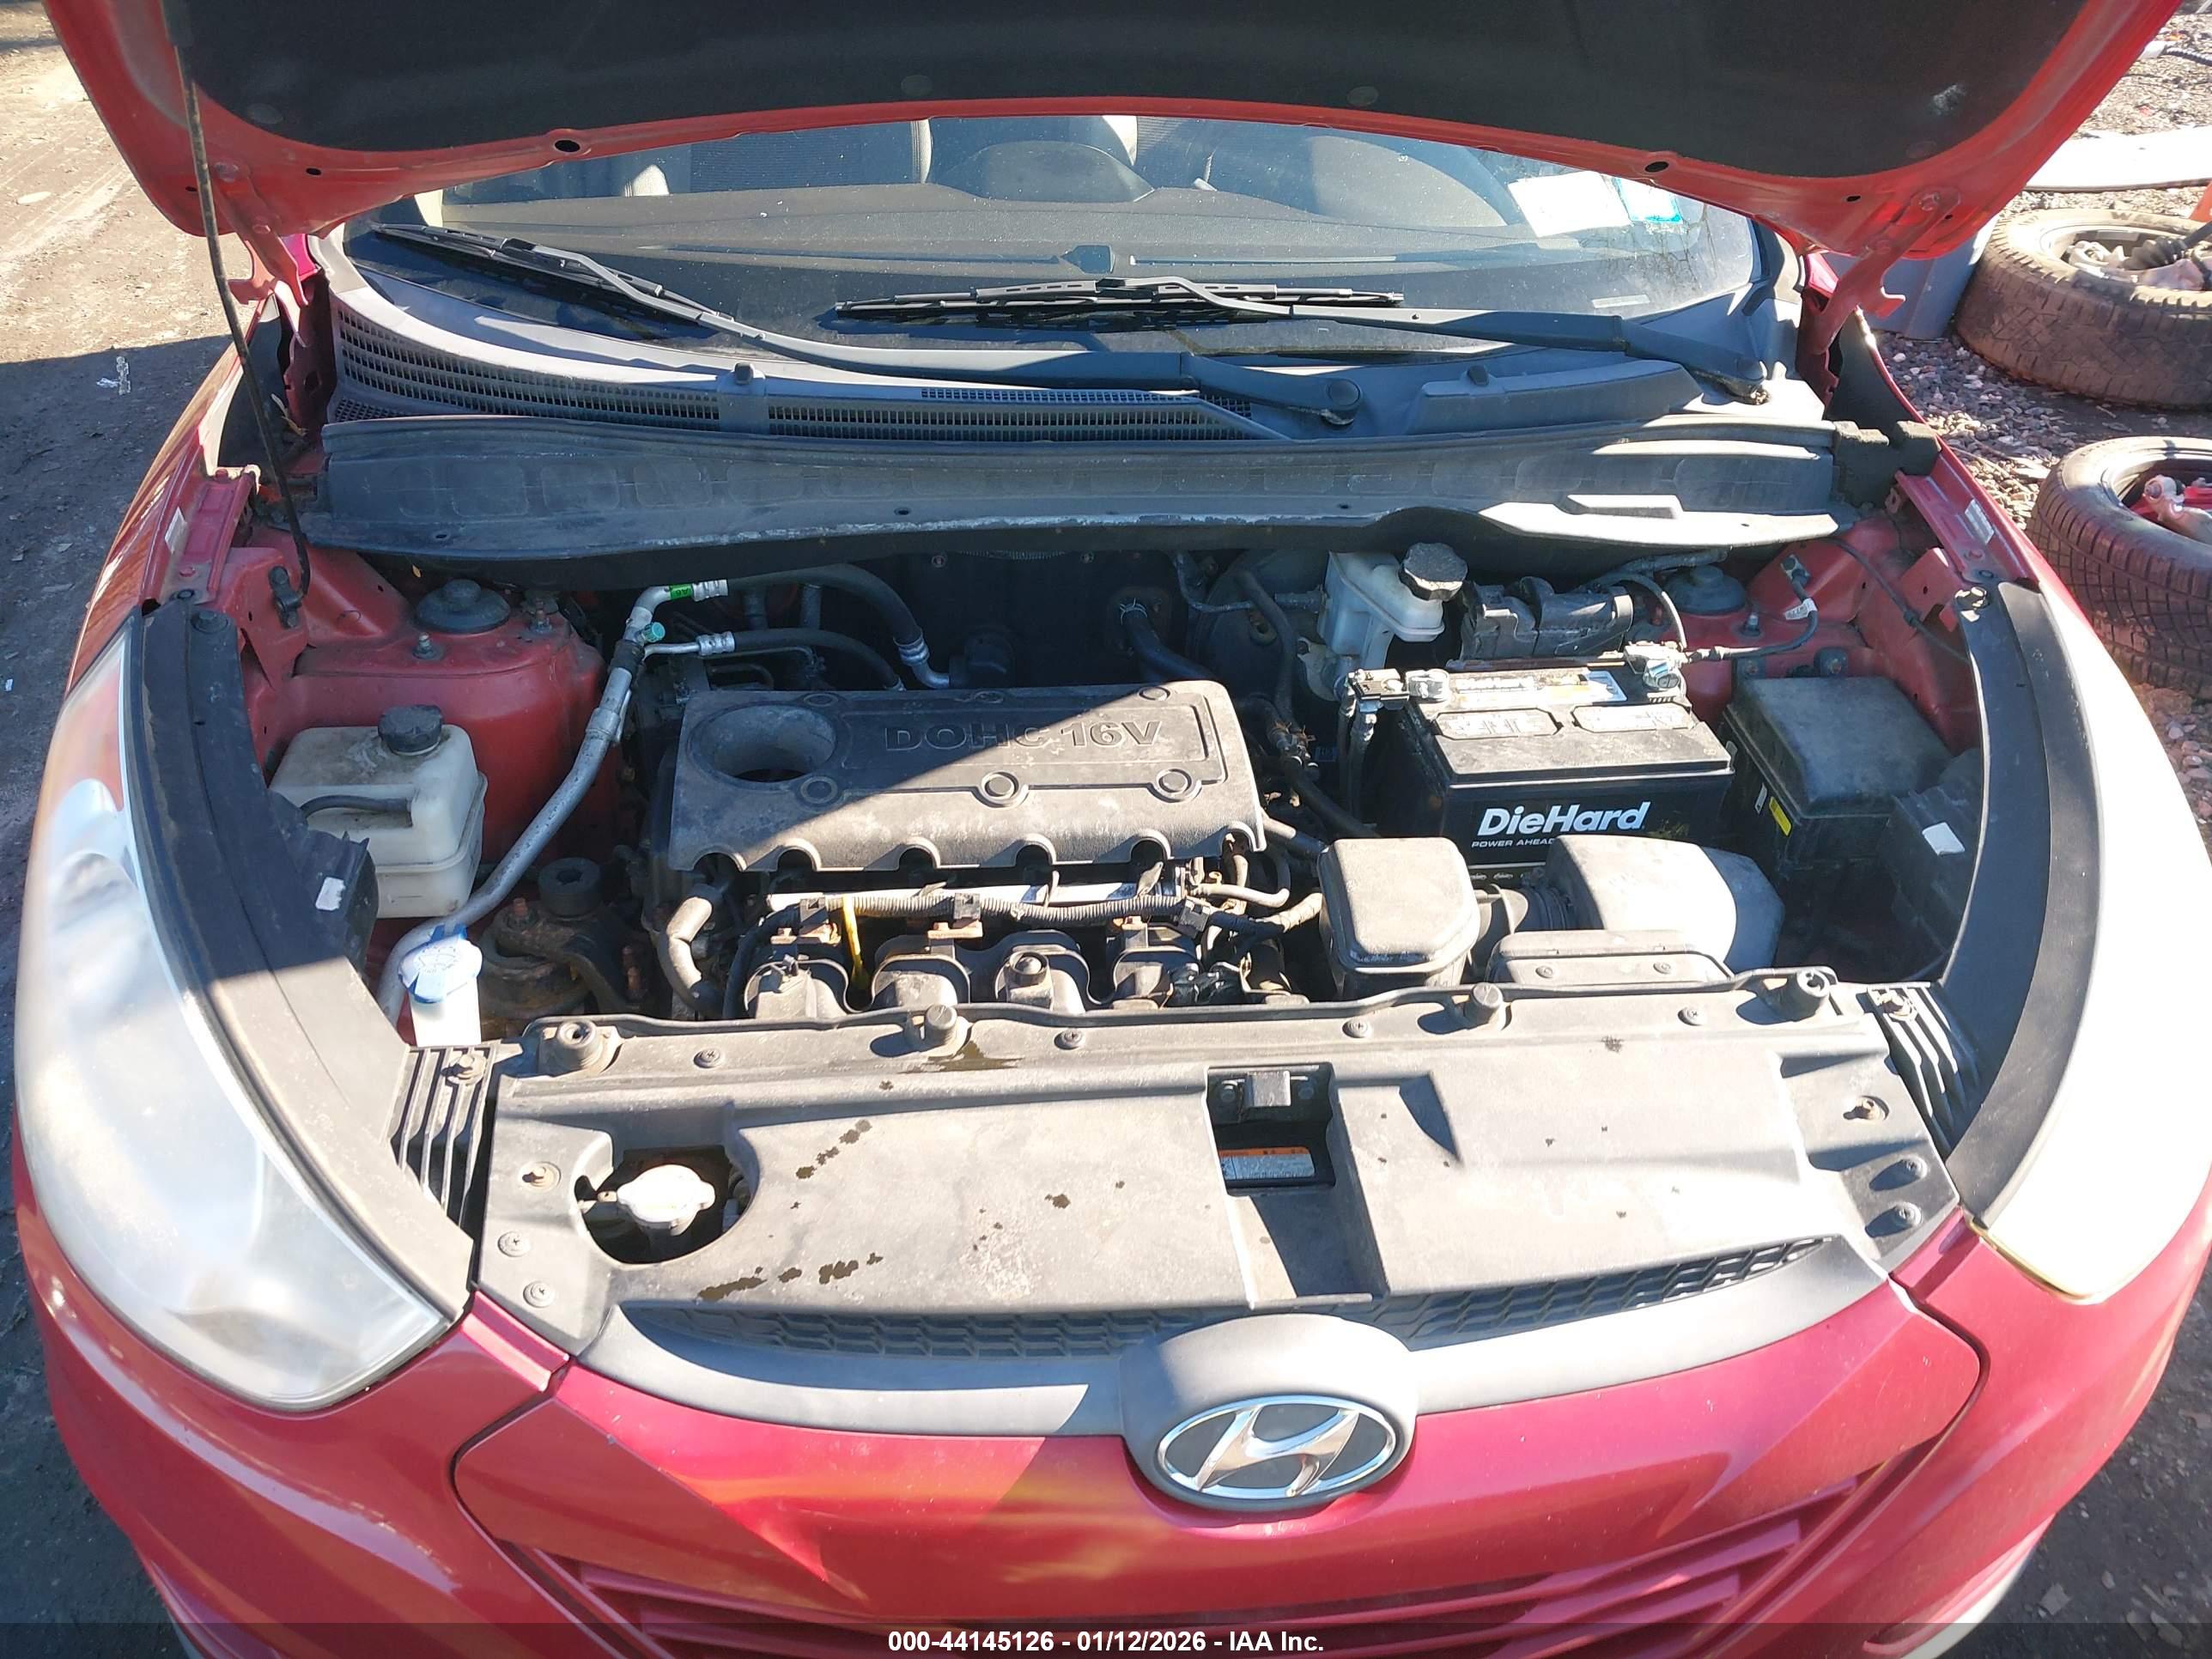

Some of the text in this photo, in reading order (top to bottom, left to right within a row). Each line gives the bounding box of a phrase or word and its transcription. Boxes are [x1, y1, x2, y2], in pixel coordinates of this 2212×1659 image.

[884, 720, 1162, 750] DOHC 16V
[1477, 801, 1651, 836] DieHard
[1471, 840, 1514, 848] POWER
